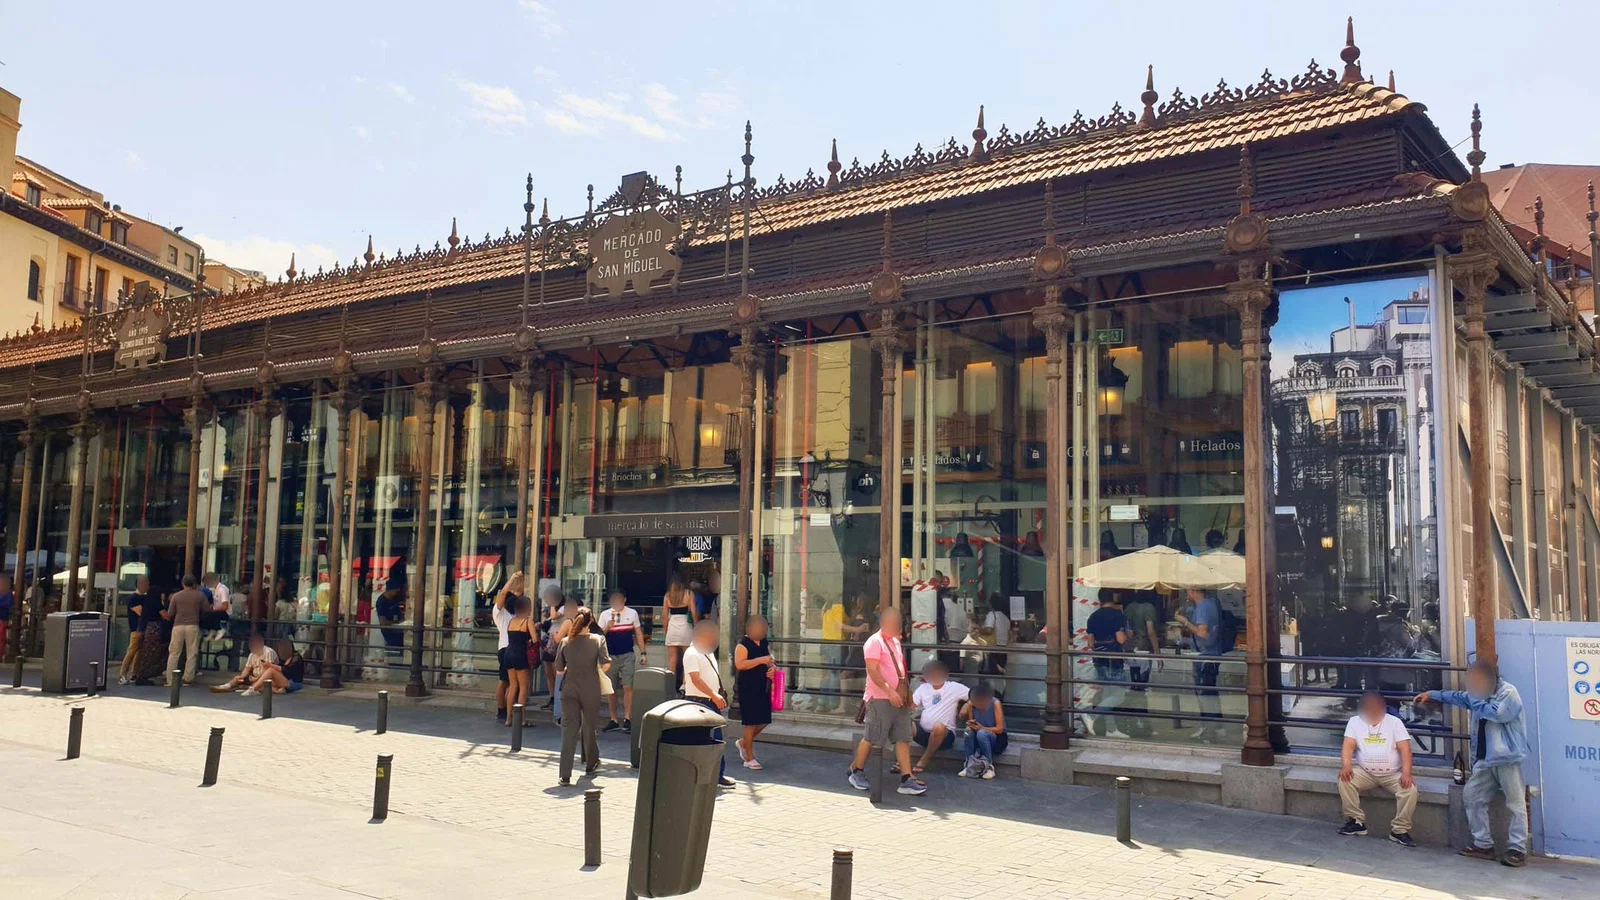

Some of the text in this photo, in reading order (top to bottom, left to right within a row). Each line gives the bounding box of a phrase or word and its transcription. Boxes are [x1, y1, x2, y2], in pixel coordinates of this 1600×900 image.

[603, 228, 662, 252] MERCADO
[624, 248, 640, 259] DE
[597, 256, 662, 279] SAN MIGUEL
[1190, 440, 1241, 453] Helados
[612, 471, 643, 481] Brioches
[607, 516, 649, 531] mercado
[651, 515, 664, 529] de
[685, 514, 719, 533] miguel
